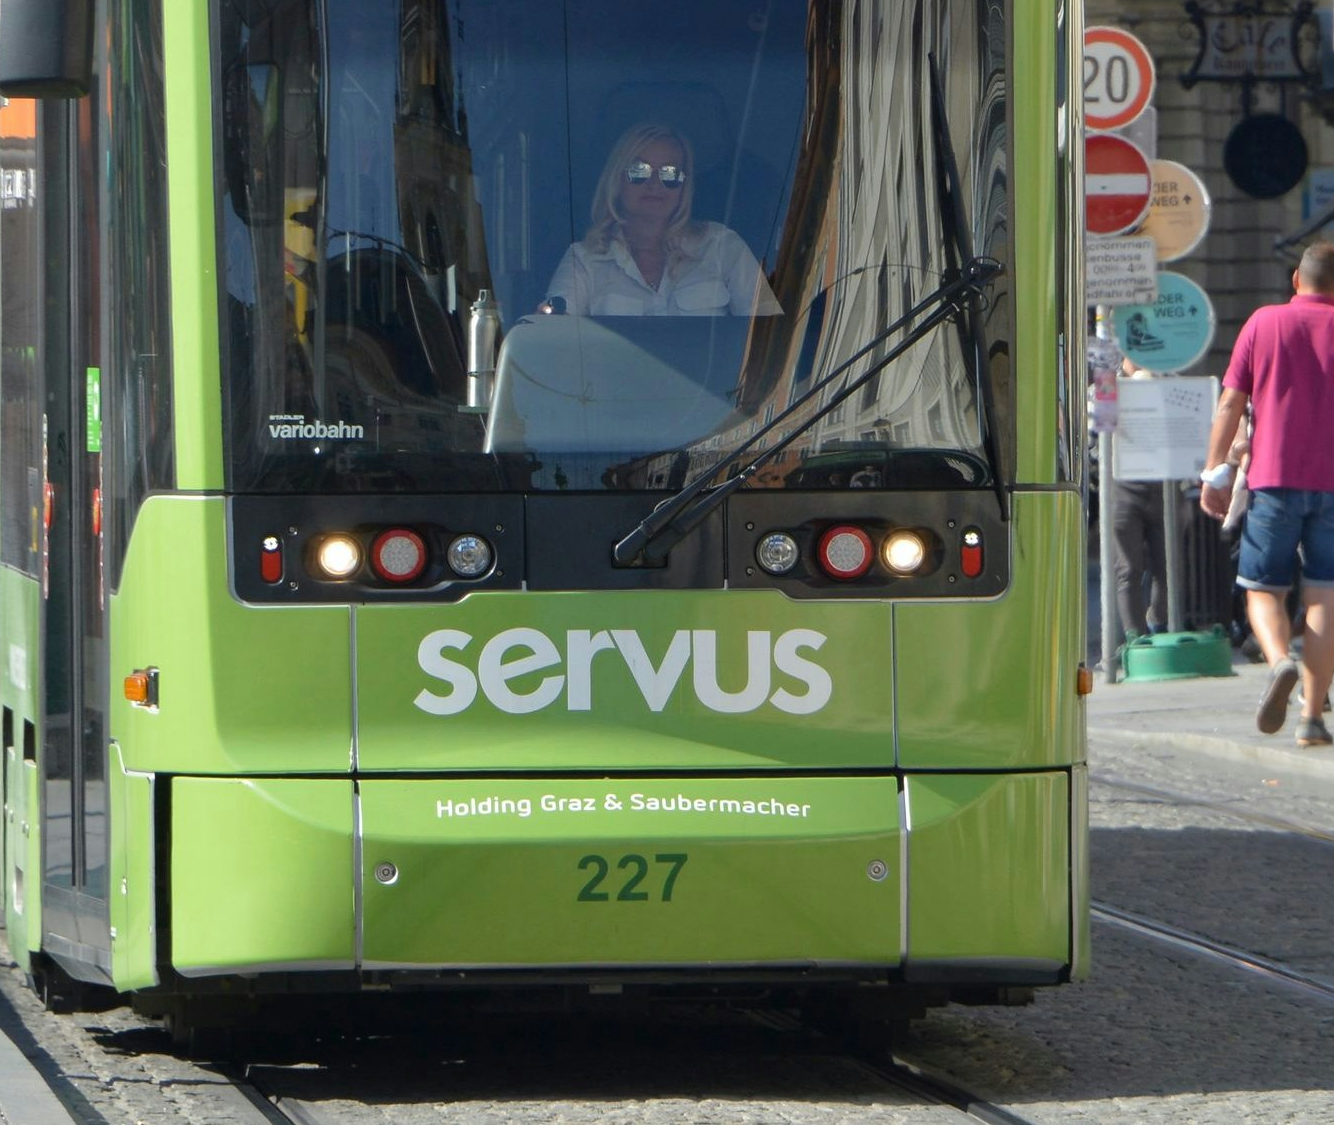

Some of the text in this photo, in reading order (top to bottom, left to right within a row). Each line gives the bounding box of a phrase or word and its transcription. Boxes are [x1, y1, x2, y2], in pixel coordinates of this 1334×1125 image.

[1085, 55, 1129, 104] 20
[269, 420, 364, 438] variobahn
[413, 626, 833, 716] servus
[436, 793, 811, 818] Holding Graz & Saubermacher
[577, 853, 689, 903] 227
